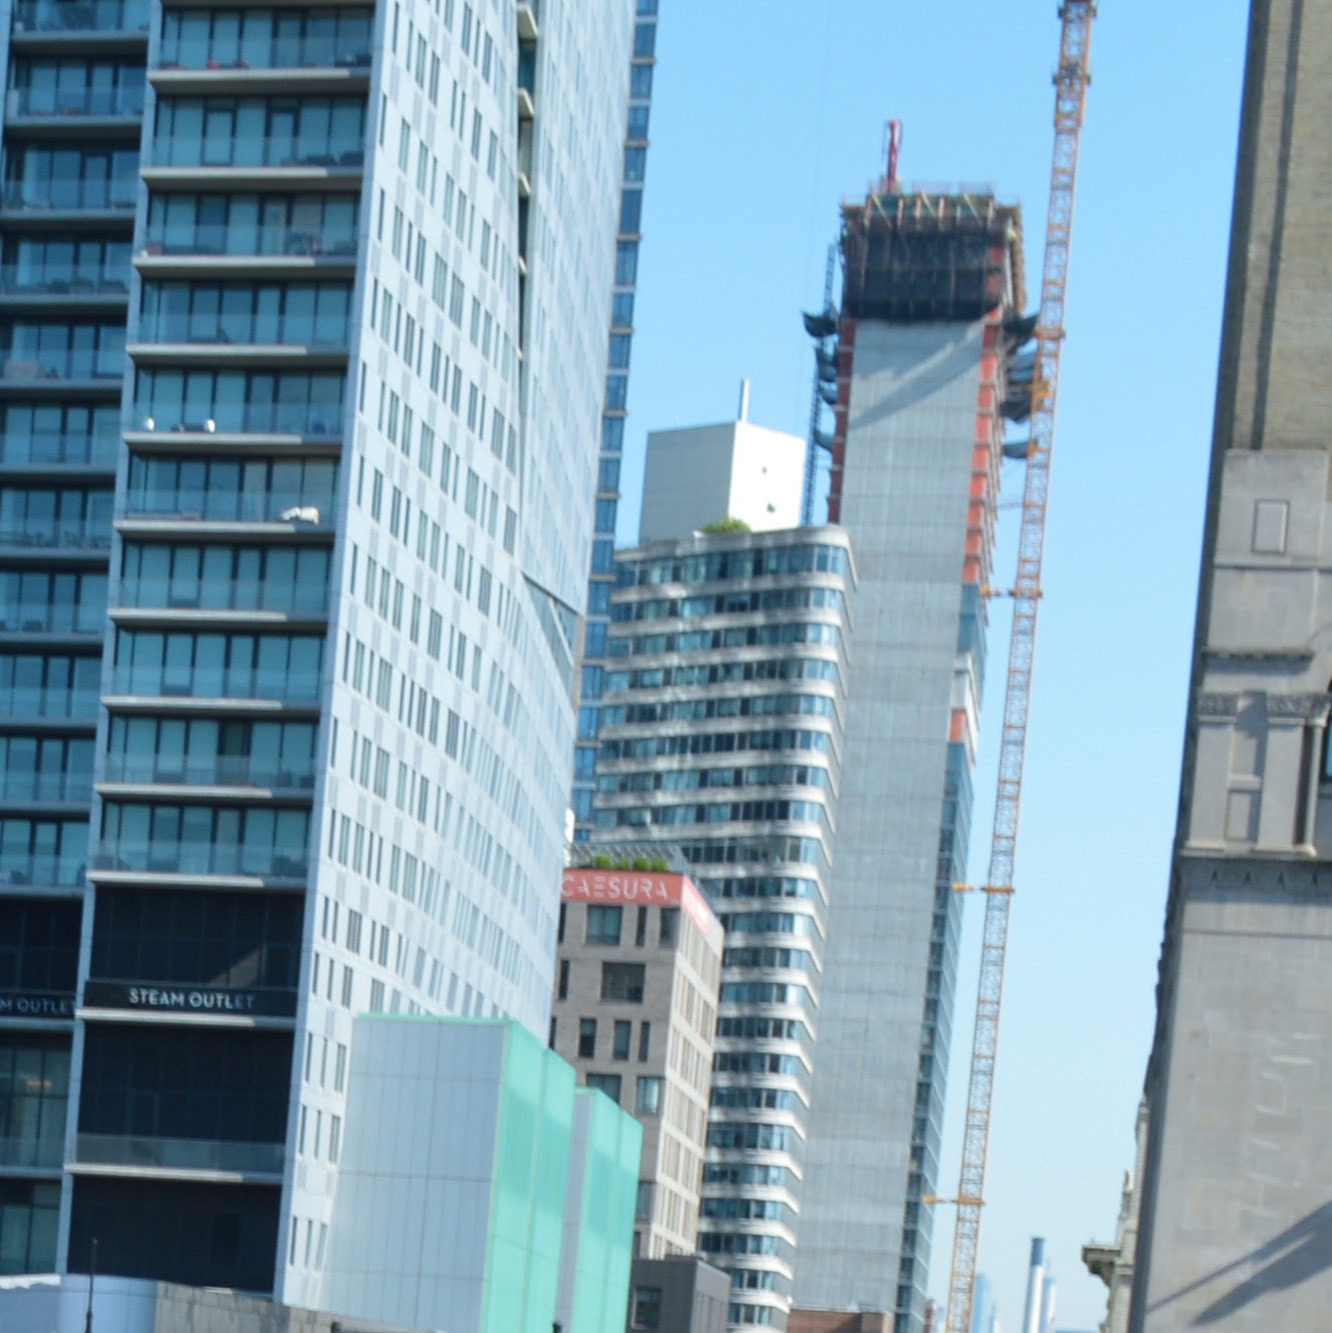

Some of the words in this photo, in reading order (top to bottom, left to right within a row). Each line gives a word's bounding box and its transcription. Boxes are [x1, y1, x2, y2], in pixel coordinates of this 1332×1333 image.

[562, 874, 668, 899] CAESURA
[129, 988, 186, 1006] STEAM
[189, 992, 254, 1009] OUTLET
